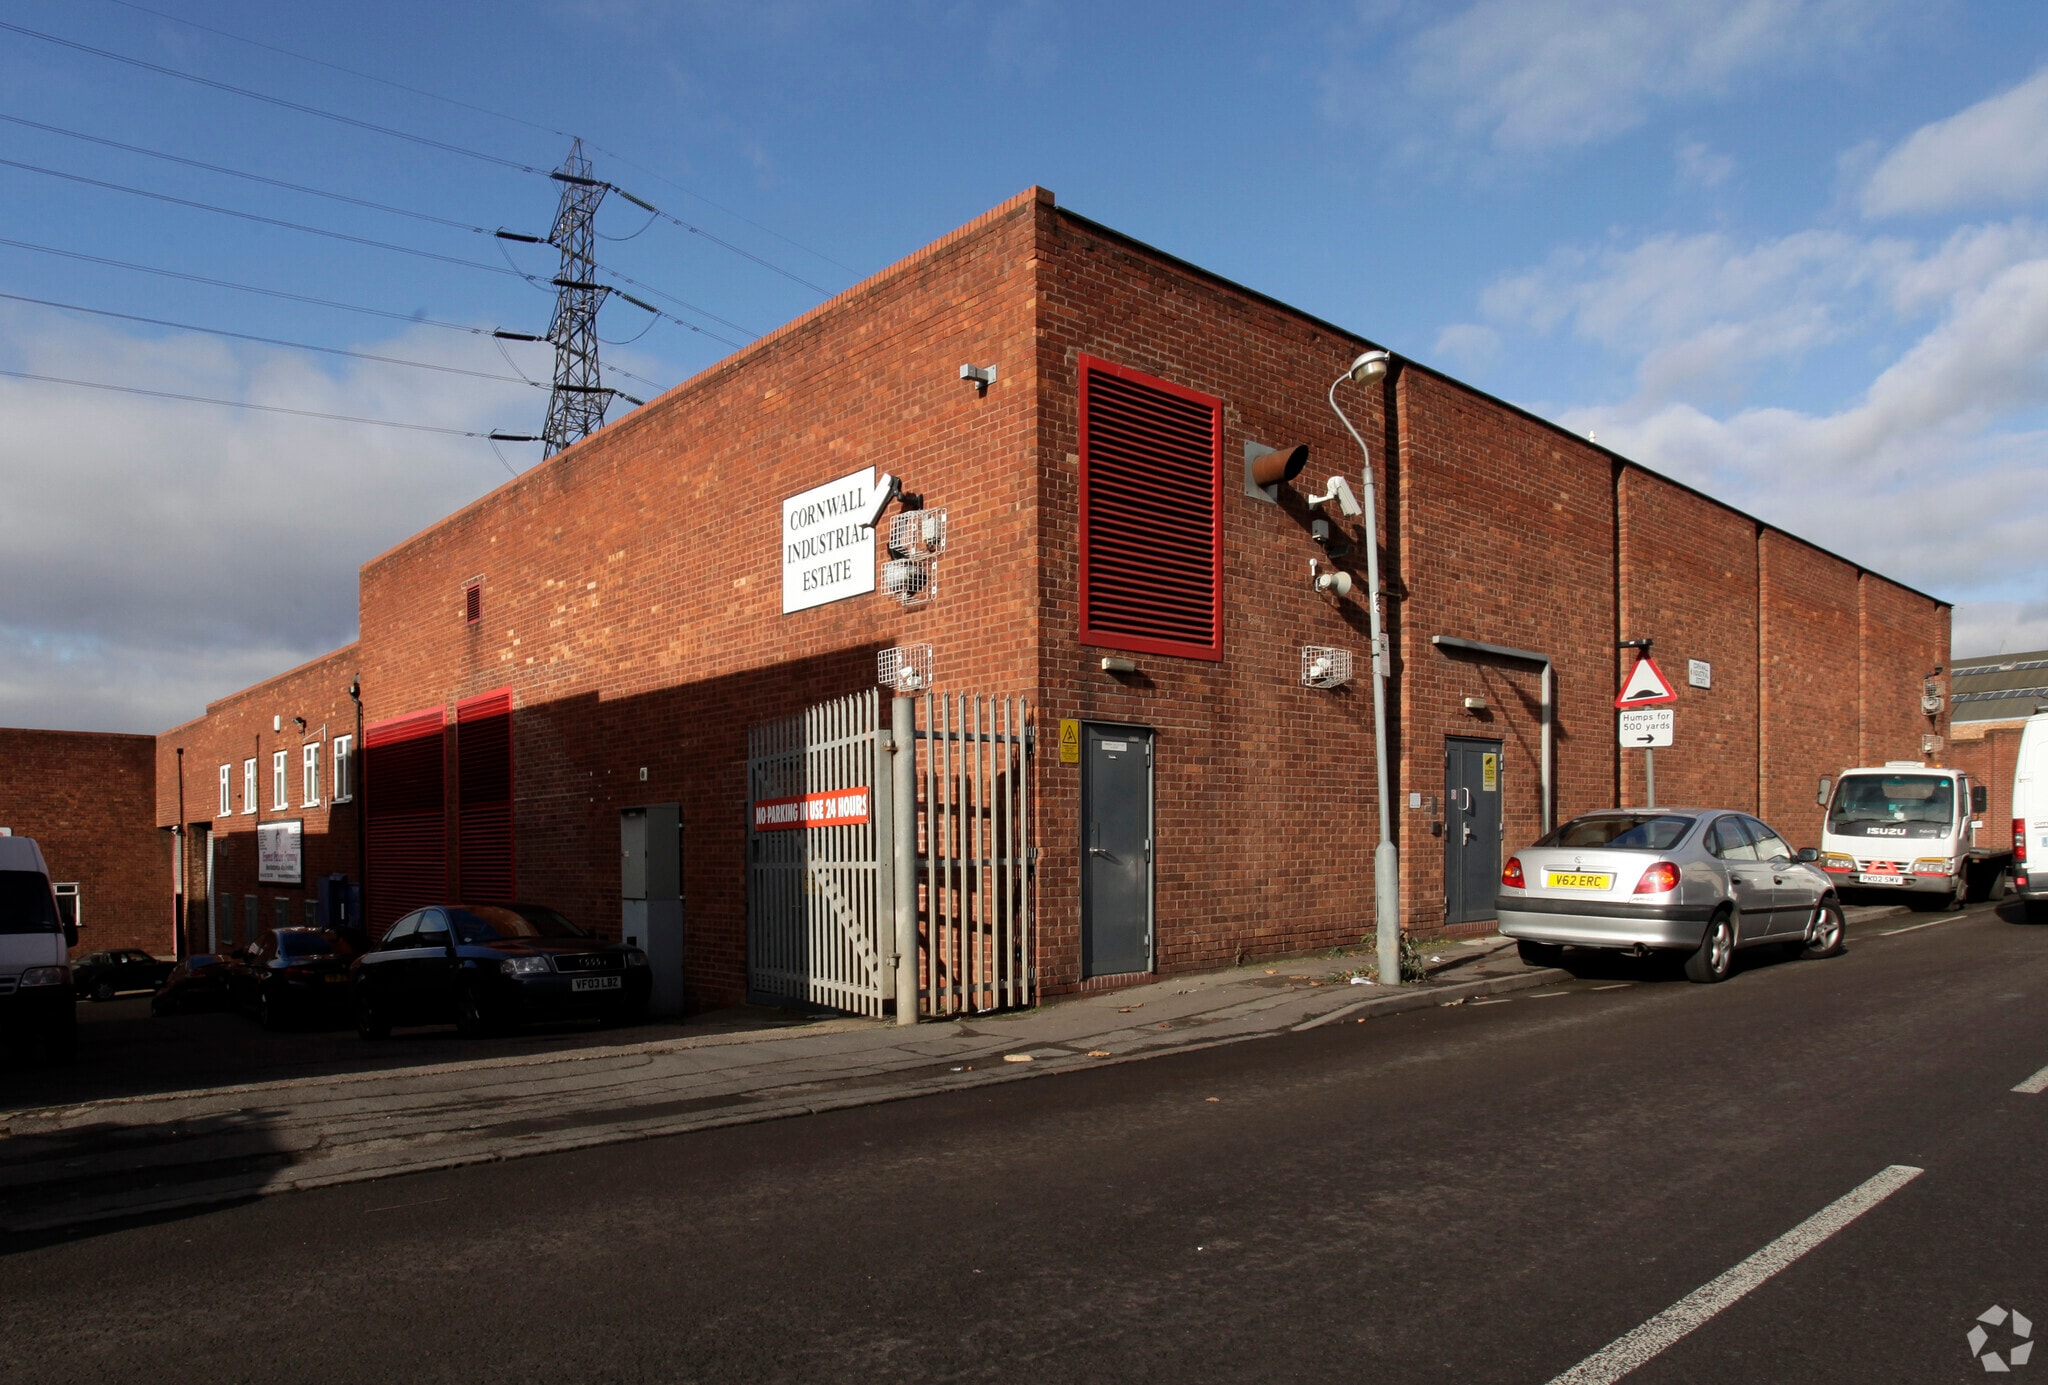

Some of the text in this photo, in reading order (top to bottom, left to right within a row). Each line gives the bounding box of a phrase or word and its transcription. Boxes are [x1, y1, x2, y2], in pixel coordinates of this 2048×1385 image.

[790, 487, 866, 531] CORNWALL
[787, 522, 869, 564] INDUSTRIAL
[802, 558, 852, 591] ESTATE
[1623, 712, 1670, 722] Humps for
[1623, 721, 1670, 731] 500 yards
[756, 794, 867, 825] NO PARKING IN USE 24 HOURS
[1866, 827, 1907, 836] ISUZU
[1556, 875, 1602, 887] V62 ERC
[1862, 874, 1883, 883] PK02
[576, 978, 600, 989] VF03
